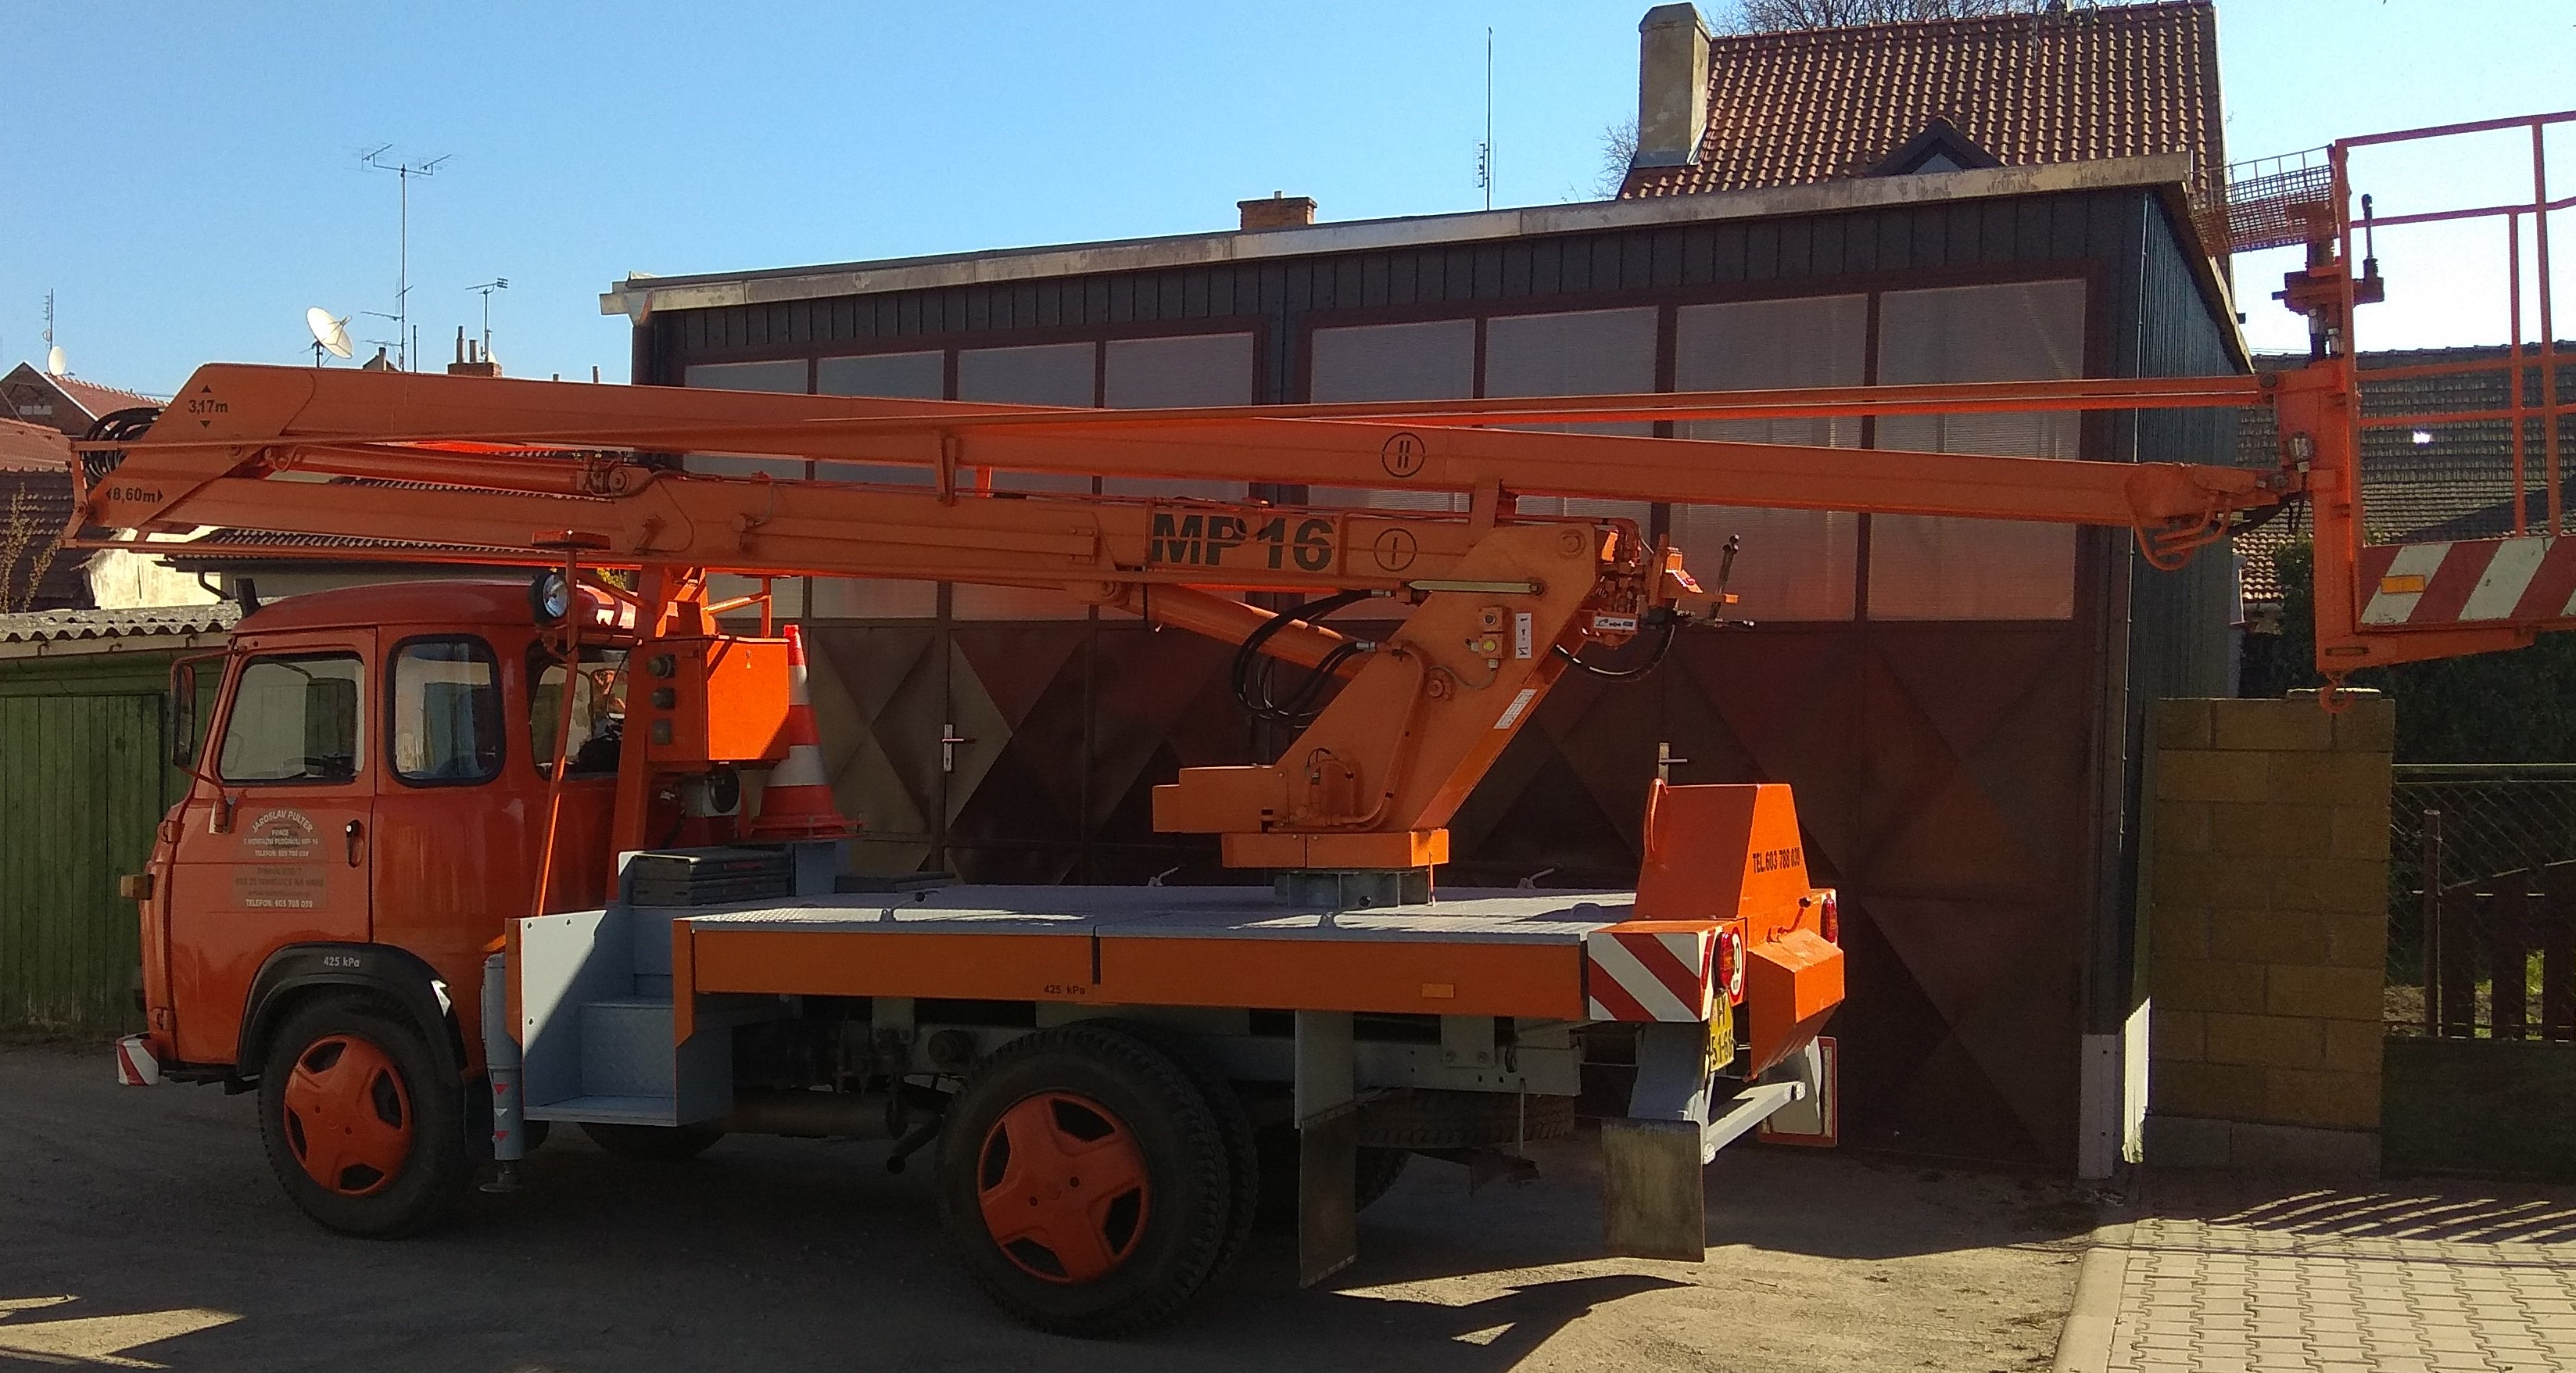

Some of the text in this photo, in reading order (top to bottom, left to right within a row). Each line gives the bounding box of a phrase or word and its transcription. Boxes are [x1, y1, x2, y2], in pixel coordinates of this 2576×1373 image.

[188, 400, 228, 414] 3,17m
[113, 487, 156, 504] 8,60m
[1152, 513, 1334, 571] MP 16
[253, 809, 313, 833] JAROSLAV PULTER
[274, 899, 287, 908] 603
[324, 956, 360, 967] 425 kPa
[1044, 984, 1086, 995] 425 kPa
